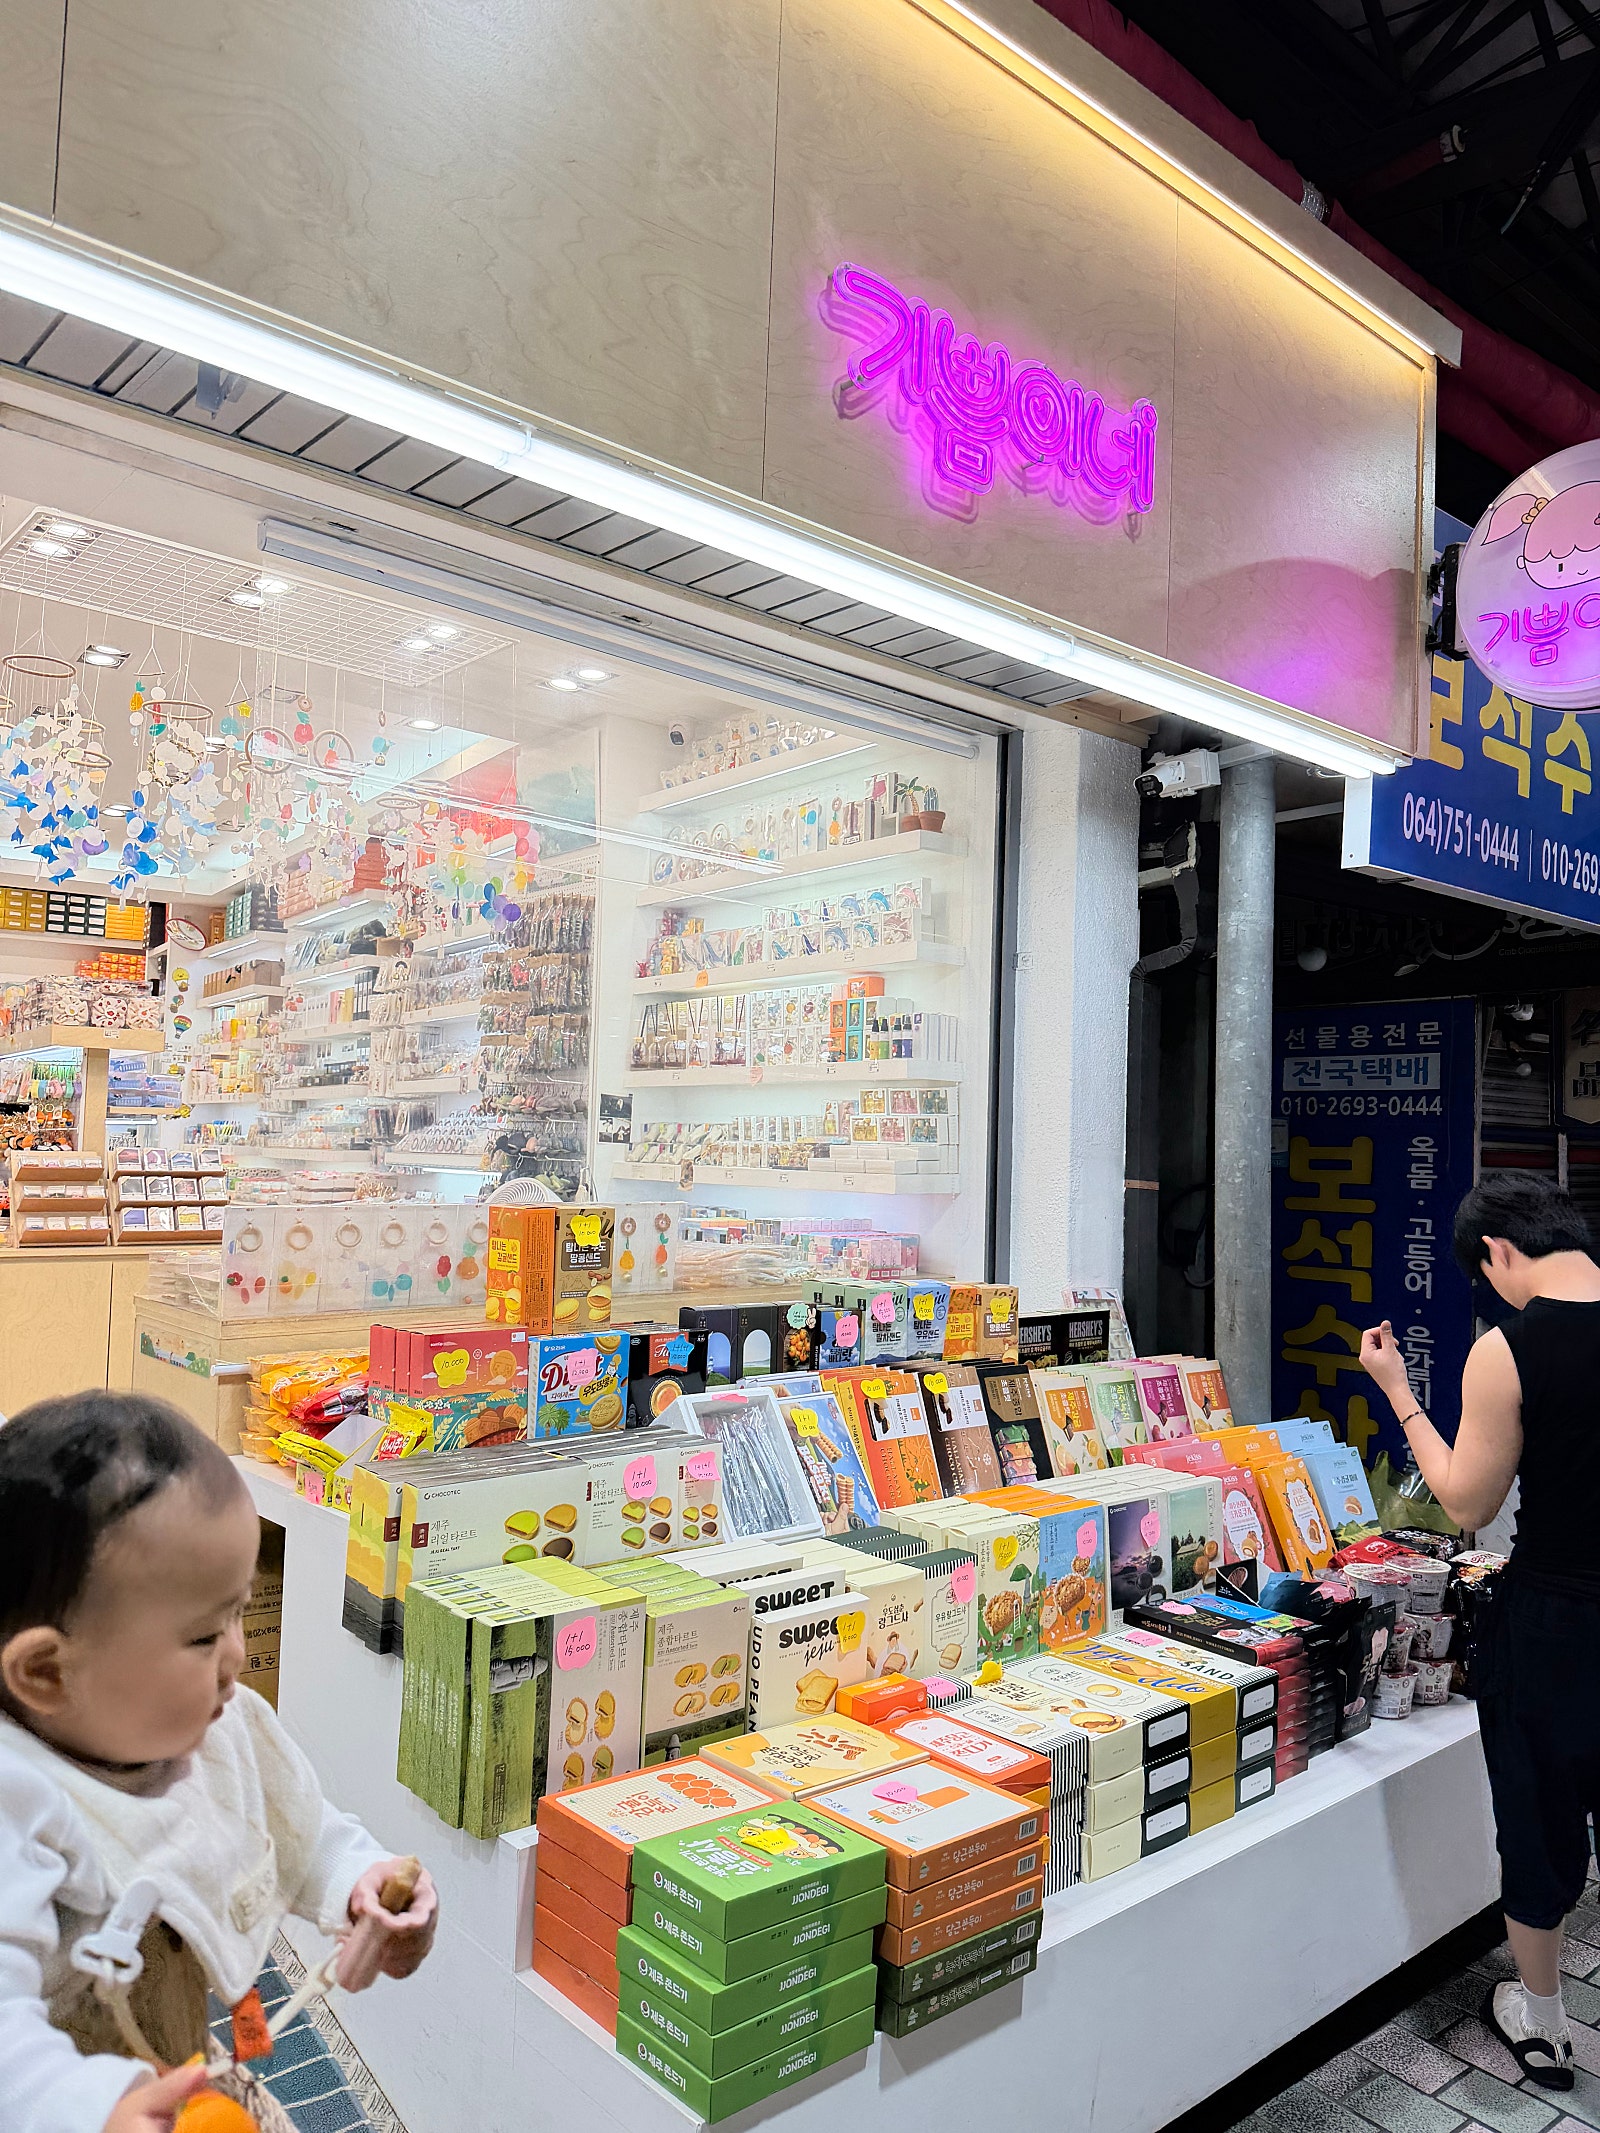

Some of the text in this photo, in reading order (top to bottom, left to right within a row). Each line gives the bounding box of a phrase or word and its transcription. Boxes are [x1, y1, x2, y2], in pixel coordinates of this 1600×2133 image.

[838, 265, 1157, 508] 기쁨이네
[1402, 791, 1600, 897] 064)751-0444 010-269
[1291, 1055, 1430, 1088] 전국택배
[1280, 1095, 1443, 1117] 010-2693-0444
[1406, 1135, 1437, 1190] 옥돔
[1403, 1217, 1436, 1300] 고등어
[1018, 1324, 1052, 1344] ERSHEY'S
[1068, 1319, 1103, 1339] HERSHEY'S
[943, 1437, 955, 1471] CHOCO
[951, 1436, 966, 1486] HALLASAN
[632, 1468, 647, 1481] 1+1
[431, 1489, 461, 1498] CHOCOTEC
[431, 1519, 450, 1532] 제주
[629, 1608, 640, 1632] 제주
[657, 1622, 675, 1635] 제주
[566, 1630, 584, 1645] 1+1
[751, 1625, 763, 1671] UDO
[1180, 1661, 1235, 1681] SAND
[611, 1797, 659, 1818] 감귤
[663, 1878, 702, 1913] 제주 쫀드기
[791, 1883, 830, 1906] JJONDEGI
[664, 1920, 703, 1955] 제주 쫀드기
[792, 1923, 831, 1946] JJONDEGI
[648, 1966, 688, 2004] 제주 쫀드기
[778, 1967, 817, 1992] JJONDEGI
[650, 2009, 689, 2048] 제주 쫀드기
[779, 2009, 819, 2036] JJONDEGI
[648, 2052, 686, 2092] 제주 쫀드기
[777, 2051, 817, 2079] JJONDEGI
